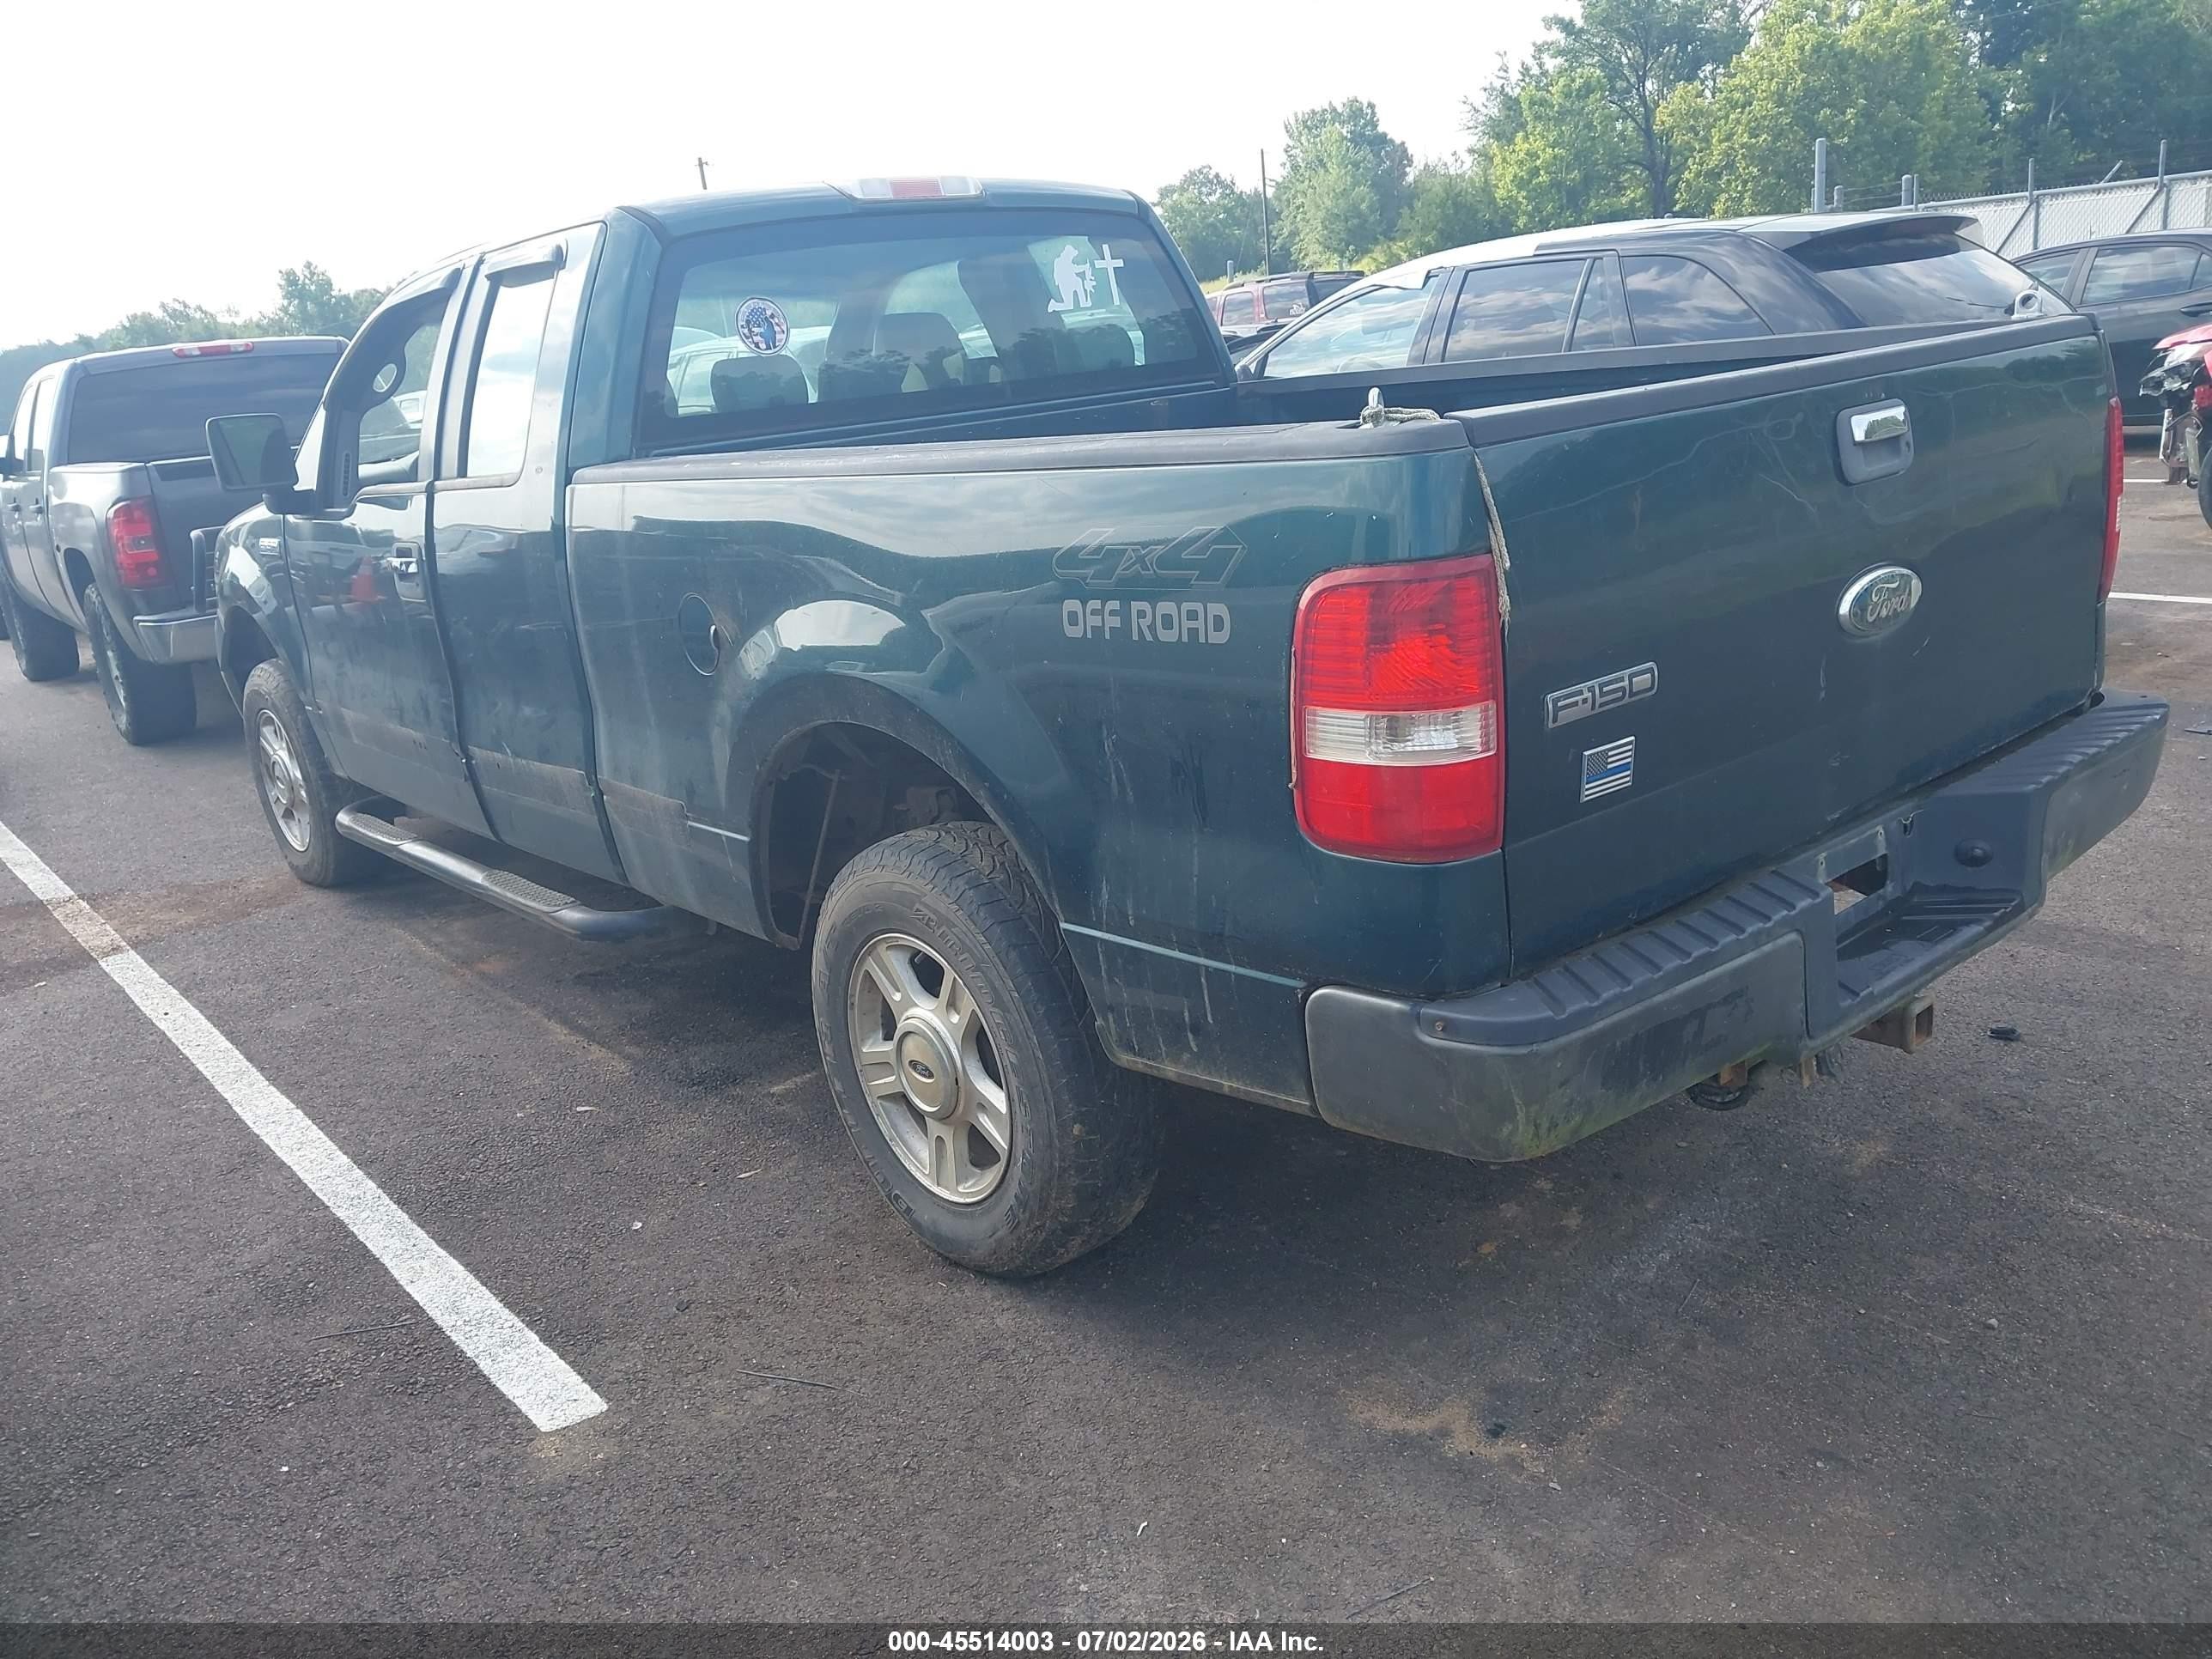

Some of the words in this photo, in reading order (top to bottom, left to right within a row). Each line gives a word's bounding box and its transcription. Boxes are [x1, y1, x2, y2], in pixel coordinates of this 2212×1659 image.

[1062, 599, 1121, 639] OFF
[1131, 601, 1231, 644] ROAD
[1867, 578, 1911, 623] Ford
[1551, 665, 1657, 726] F-150
